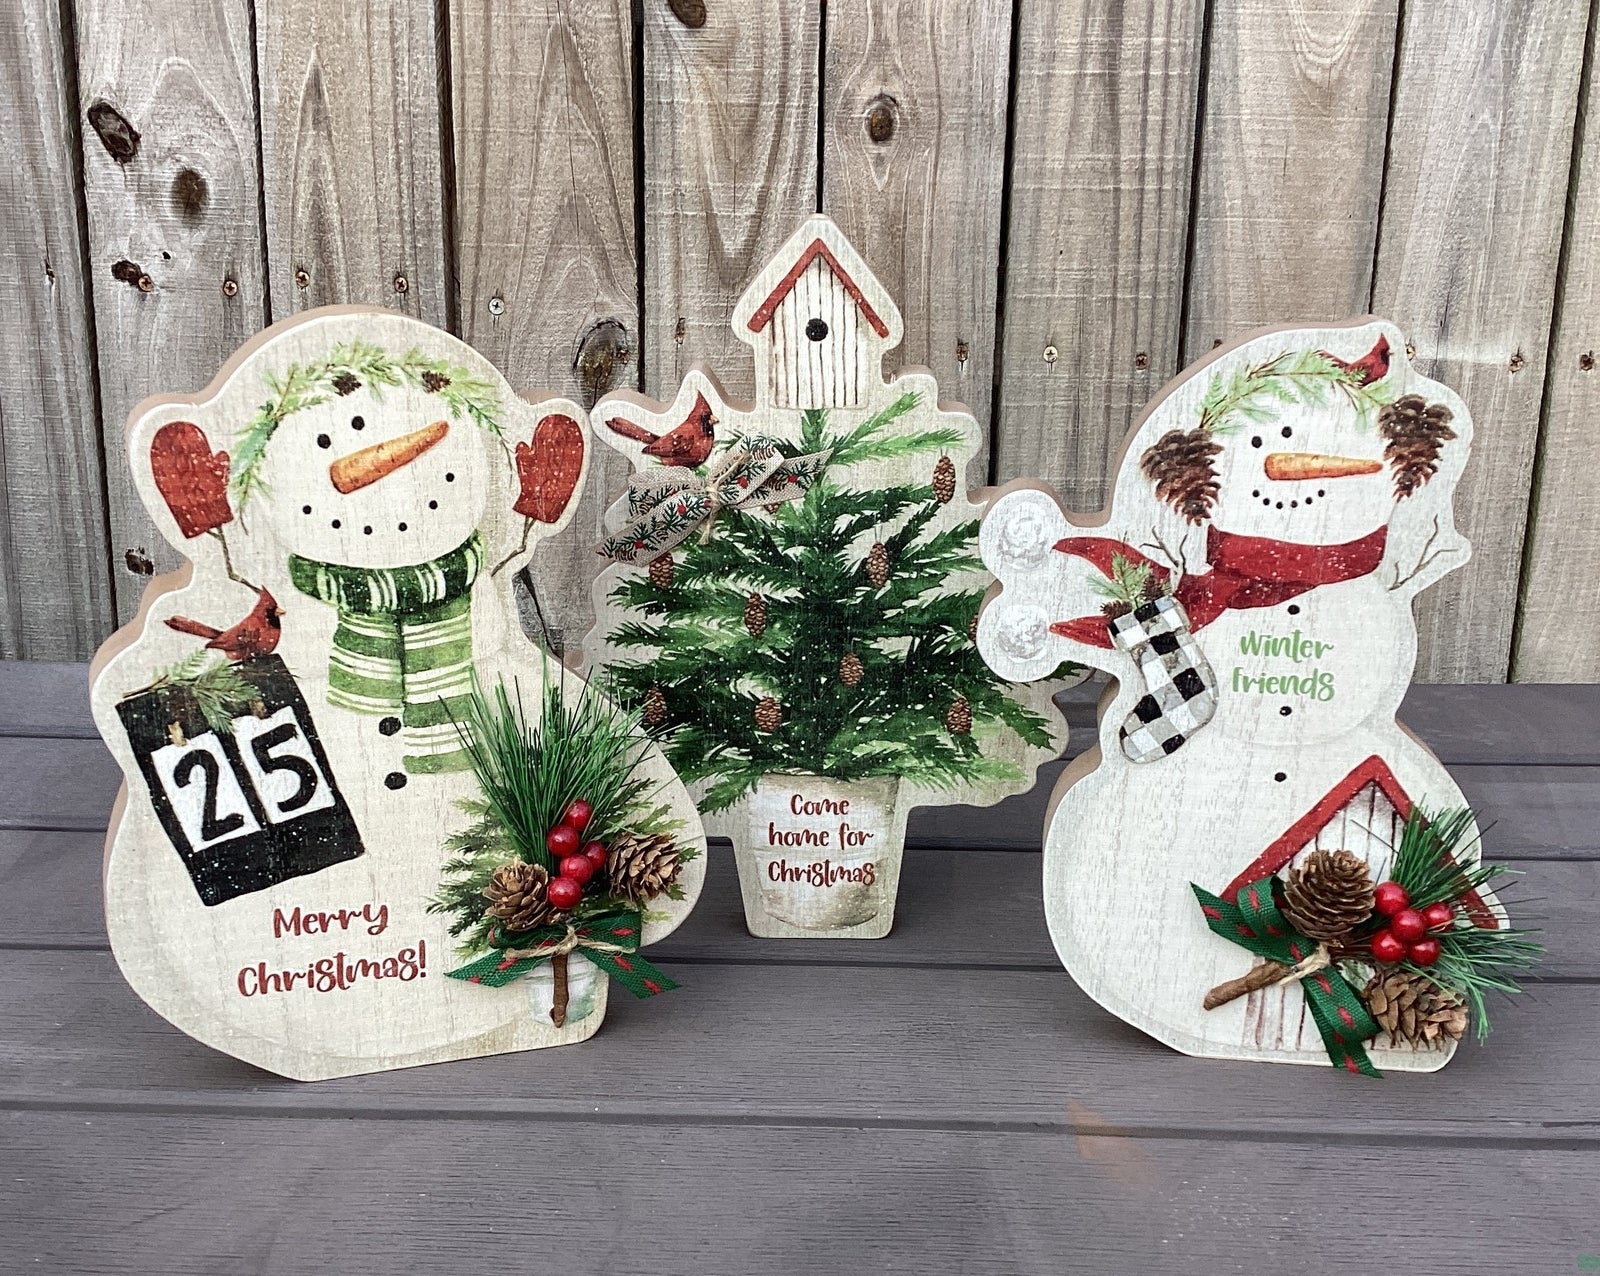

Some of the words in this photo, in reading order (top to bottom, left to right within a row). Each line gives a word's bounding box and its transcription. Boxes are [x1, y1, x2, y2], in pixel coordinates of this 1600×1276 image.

[1240, 629, 1334, 663] Winter
[1232, 666, 1335, 701] Friends
[173, 722, 318, 841] 25
[790, 793, 850, 816] Come
[768, 821, 830, 847] home
[838, 822, 874, 850] for
[768, 859, 876, 888] Christmas
[273, 903, 389, 939] Merry
[237, 939, 427, 998] Christmas!
